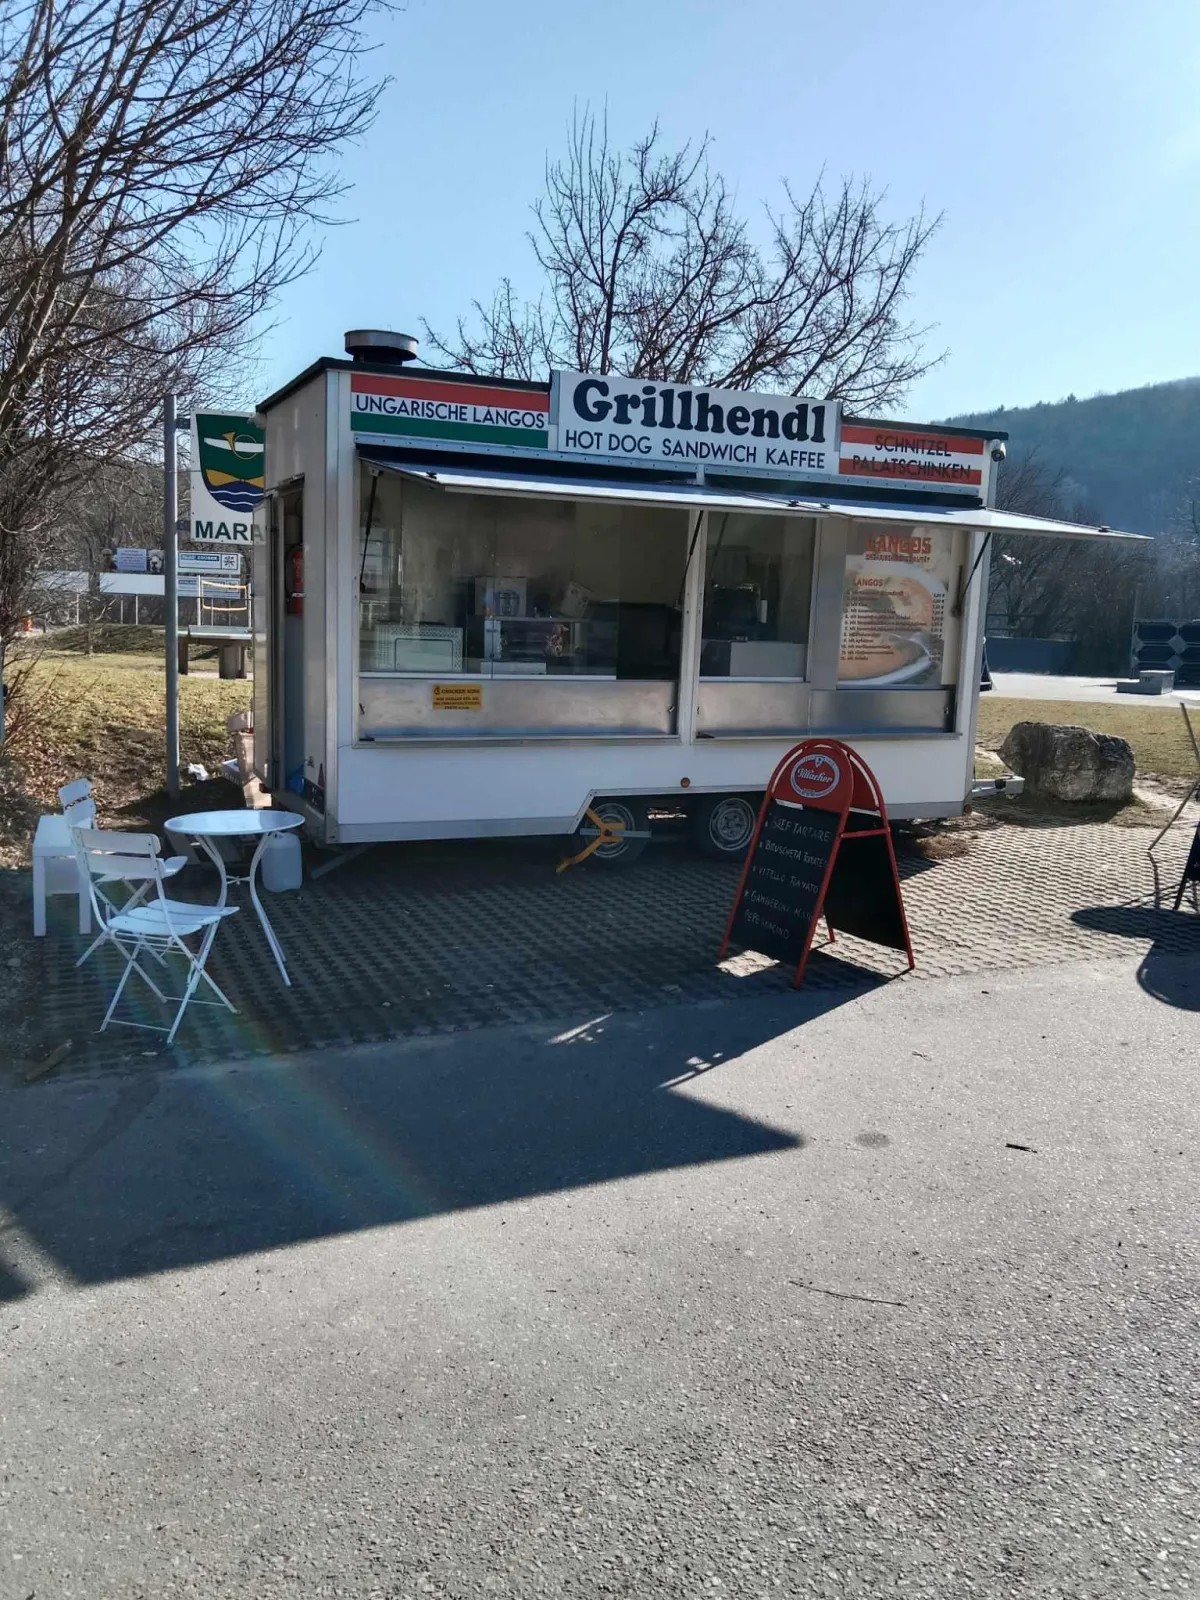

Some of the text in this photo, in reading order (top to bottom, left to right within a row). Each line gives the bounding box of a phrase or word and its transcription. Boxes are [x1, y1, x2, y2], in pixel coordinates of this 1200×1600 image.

[355, 394, 468, 422] UNGARISCHE
[573, 378, 826, 443] Grillhendl
[565, 429, 826, 469] HOT DOG SANDWICH KAFFEE
[874, 434, 952, 457] SCHNITZEL
[852, 455, 972, 480] PALATSCHINKEN
